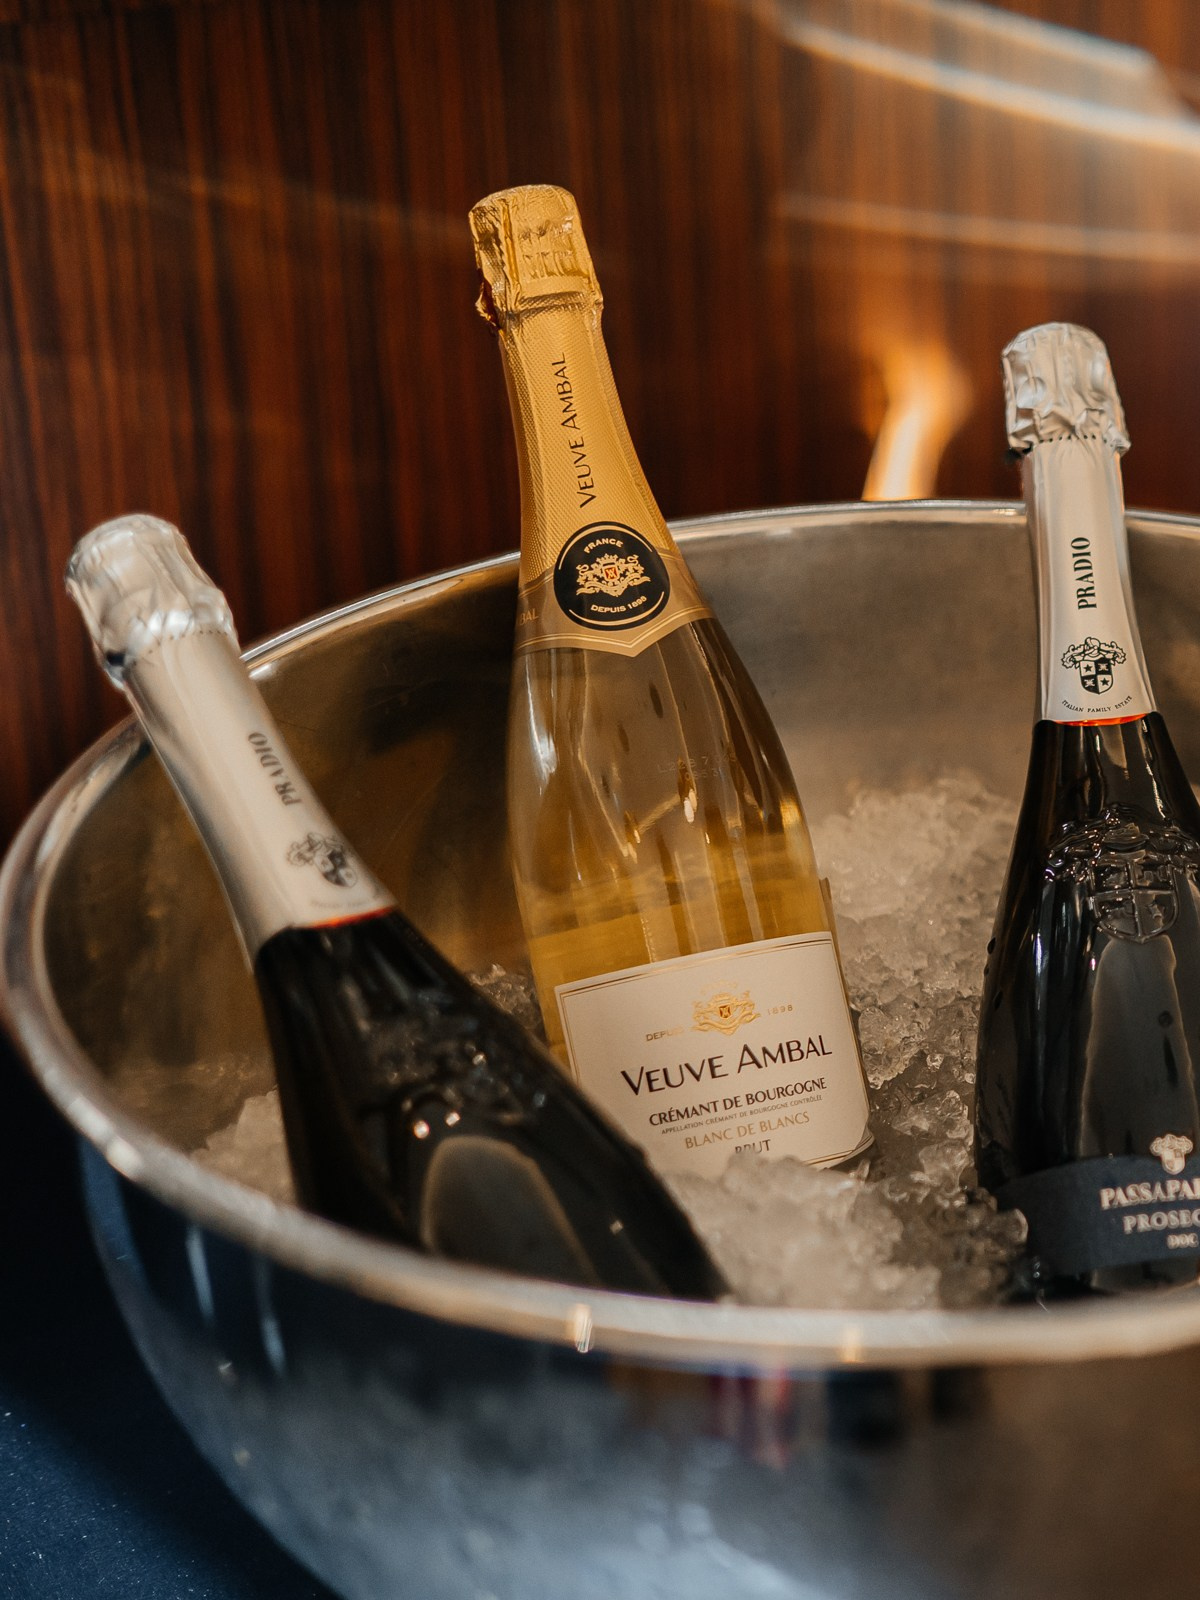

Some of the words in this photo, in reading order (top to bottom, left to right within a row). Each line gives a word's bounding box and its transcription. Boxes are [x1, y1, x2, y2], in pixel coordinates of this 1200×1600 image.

[551, 352, 581, 431] AMBAL
[568, 436, 597, 509] VEUVE
[583, 537, 624, 554] FRANCE
[1070, 536, 1098, 611] PRADIO
[590, 604, 627, 613] DEPUIS
[1061, 699, 1084, 713] ITALIAN
[1114, 695, 1133, 710] ESTATE
[248, 732, 302, 806] PRADIO
[645, 1026, 684, 1041] DEPU
[767, 1004, 793, 1015] 1898
[620, 1054, 730, 1096] VEUVE
[736, 1034, 833, 1074] AMBAL
[648, 1100, 720, 1127] CRÉMANT
[723, 1096, 744, 1112] DE
[746, 1077, 828, 1106] BOURGOGNE
[661, 1121, 704, 1136] APPELLATION
[705, 1114, 738, 1127] CRÉMANT
[749, 1102, 790, 1117] BOURGOGNE
[684, 1128, 734, 1150] BLANC
[737, 1122, 757, 1138] DE
[759, 1111, 811, 1133] BLANCS
[1166, 1232, 1199, 1249] DOC
